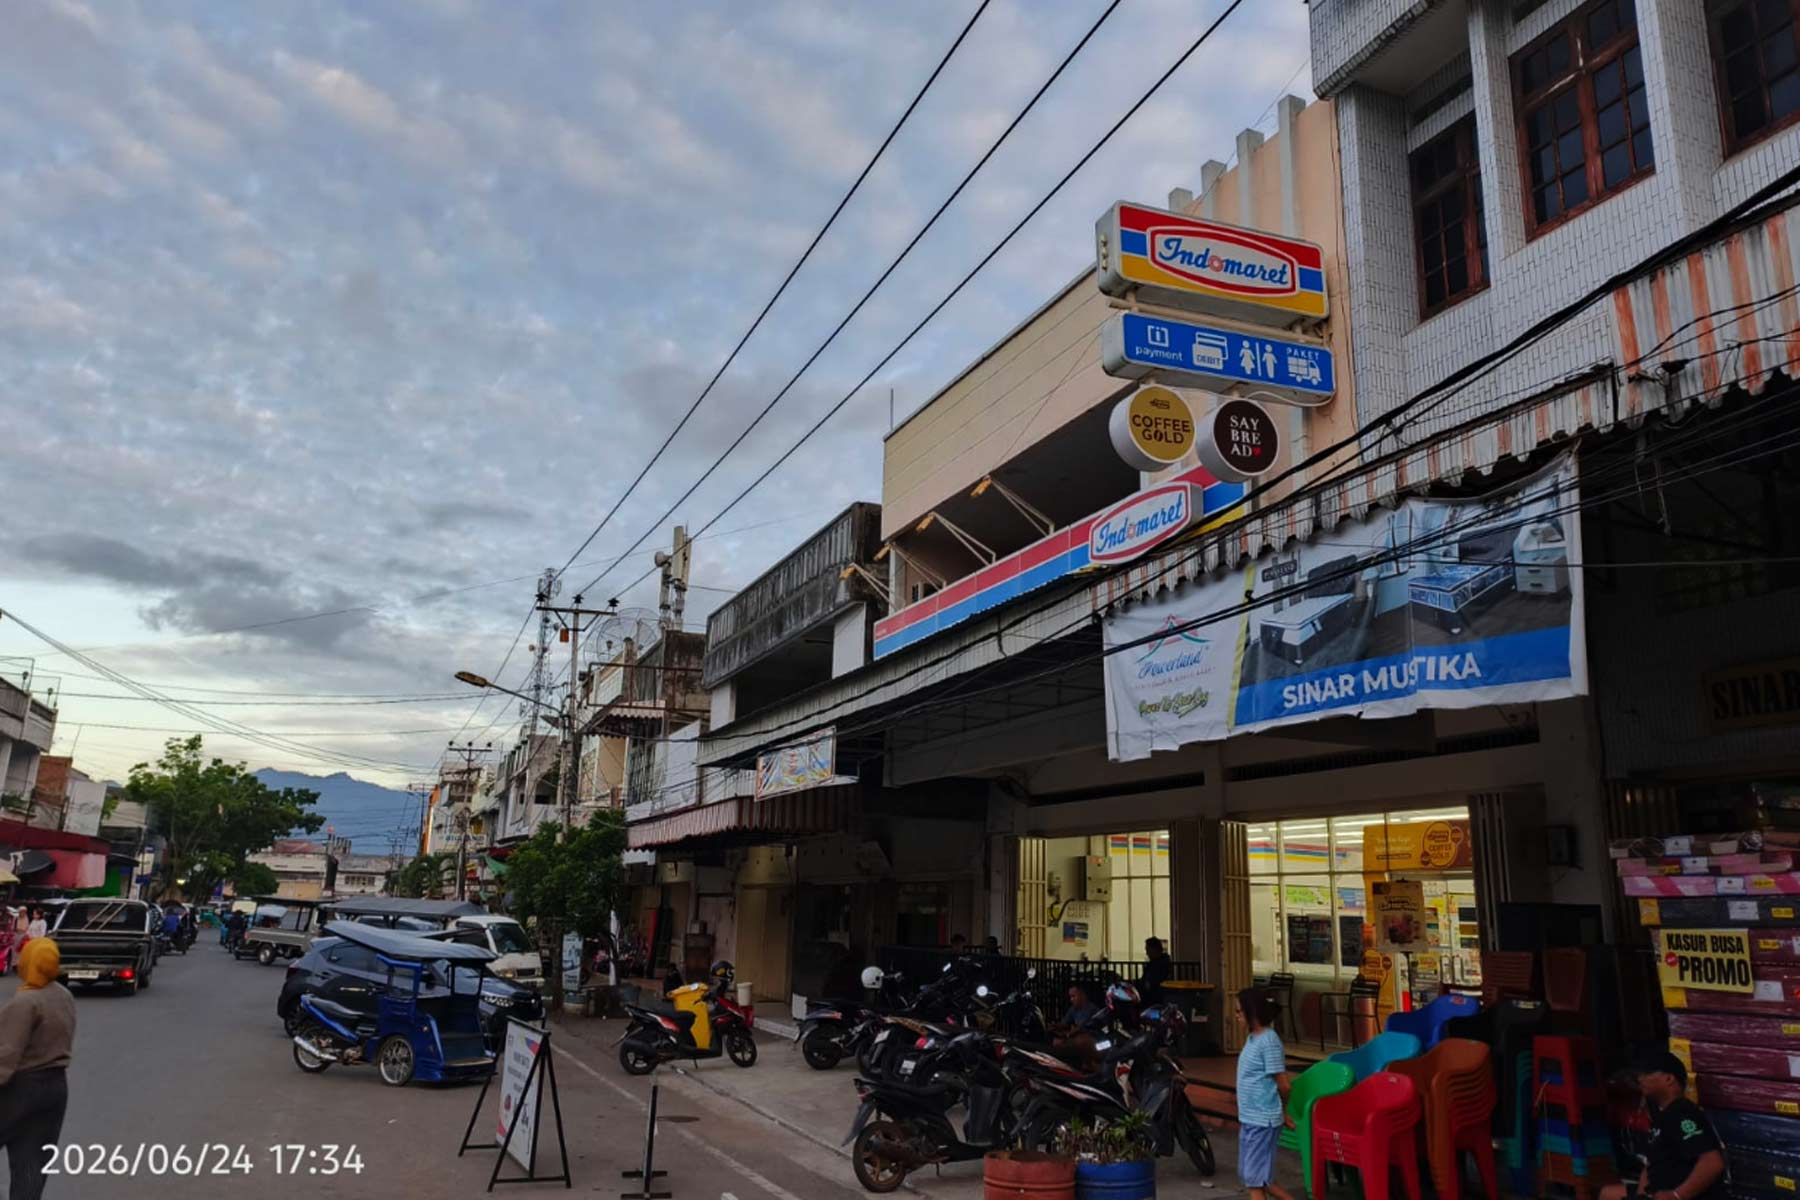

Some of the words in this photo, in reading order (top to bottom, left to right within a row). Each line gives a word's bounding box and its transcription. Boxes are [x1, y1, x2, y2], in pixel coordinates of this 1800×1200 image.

[1158, 237, 1289, 285] Indomaret
[1135, 345, 1183, 362] payment
[1196, 354, 1222, 367] DEBIT
[1286, 346, 1320, 361] PAKET
[1131, 414, 1191, 433] COFFEE
[1230, 415, 1260, 431] SAY
[1142, 428, 1184, 444] GOLD
[1231, 429, 1261, 445] BRE
[1230, 442, 1253, 457] AD
[1096, 492, 1183, 553] Indomaret
[1282, 673, 1356, 709] SINAR
[1363, 652, 1482, 692] MUSTIKA
[1666, 933, 1708, 953] KASUR
[1710, 935, 1745, 954] BUSA
[1678, 955, 1751, 987] PROMO
